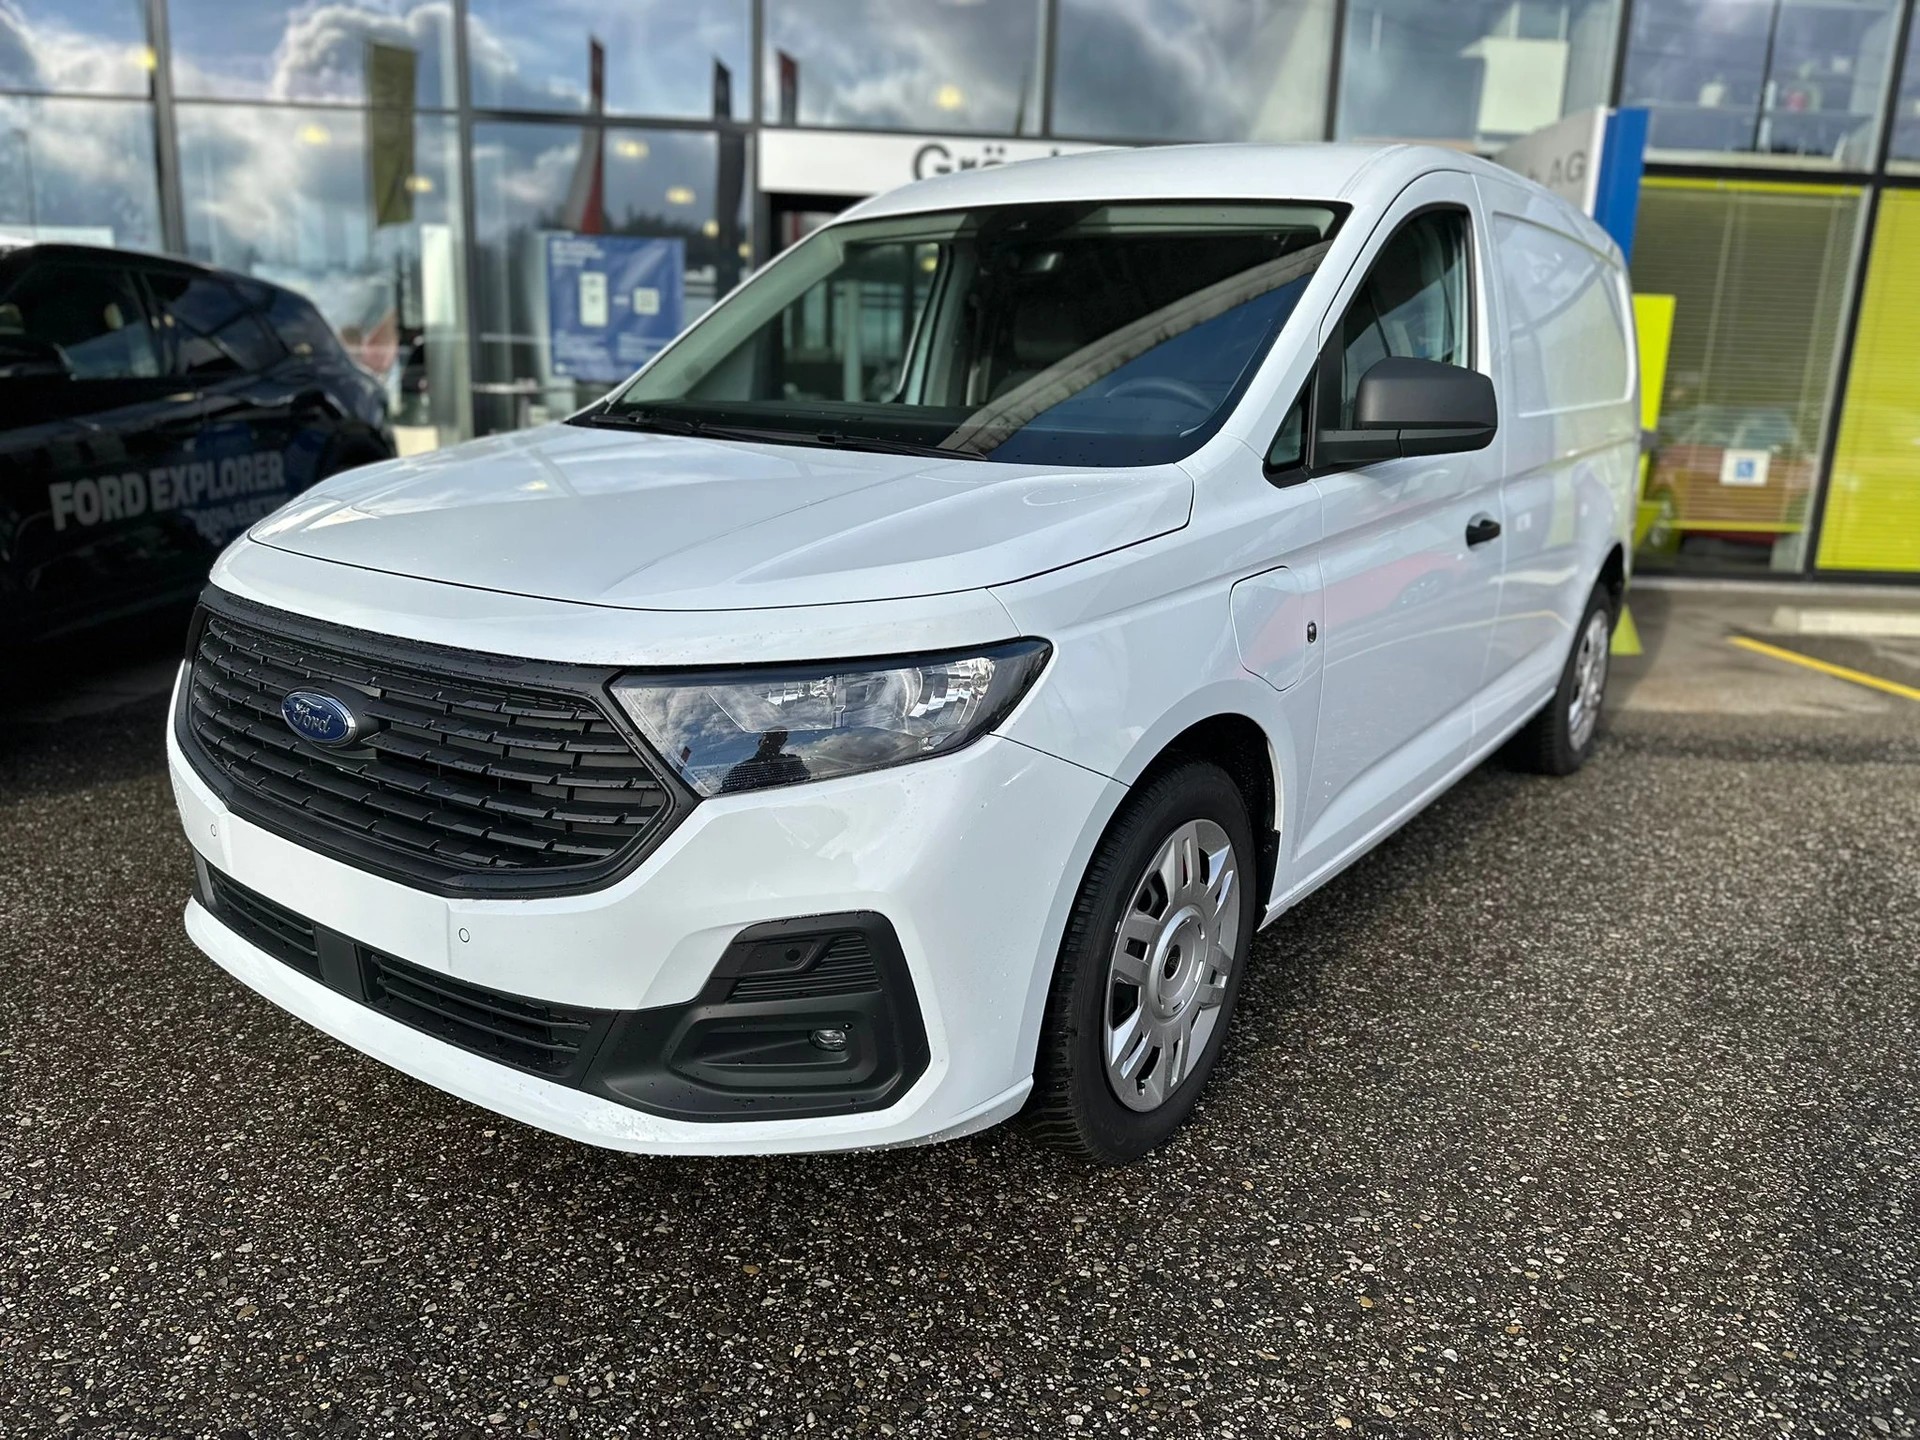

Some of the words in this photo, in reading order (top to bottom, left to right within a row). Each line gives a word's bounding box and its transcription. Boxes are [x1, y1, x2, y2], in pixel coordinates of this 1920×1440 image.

[1549, 151, 1586, 186] AG
[49, 472, 147, 531] FORD
[149, 451, 285, 511] EXPLORER
[293, 698, 333, 734] Ford
